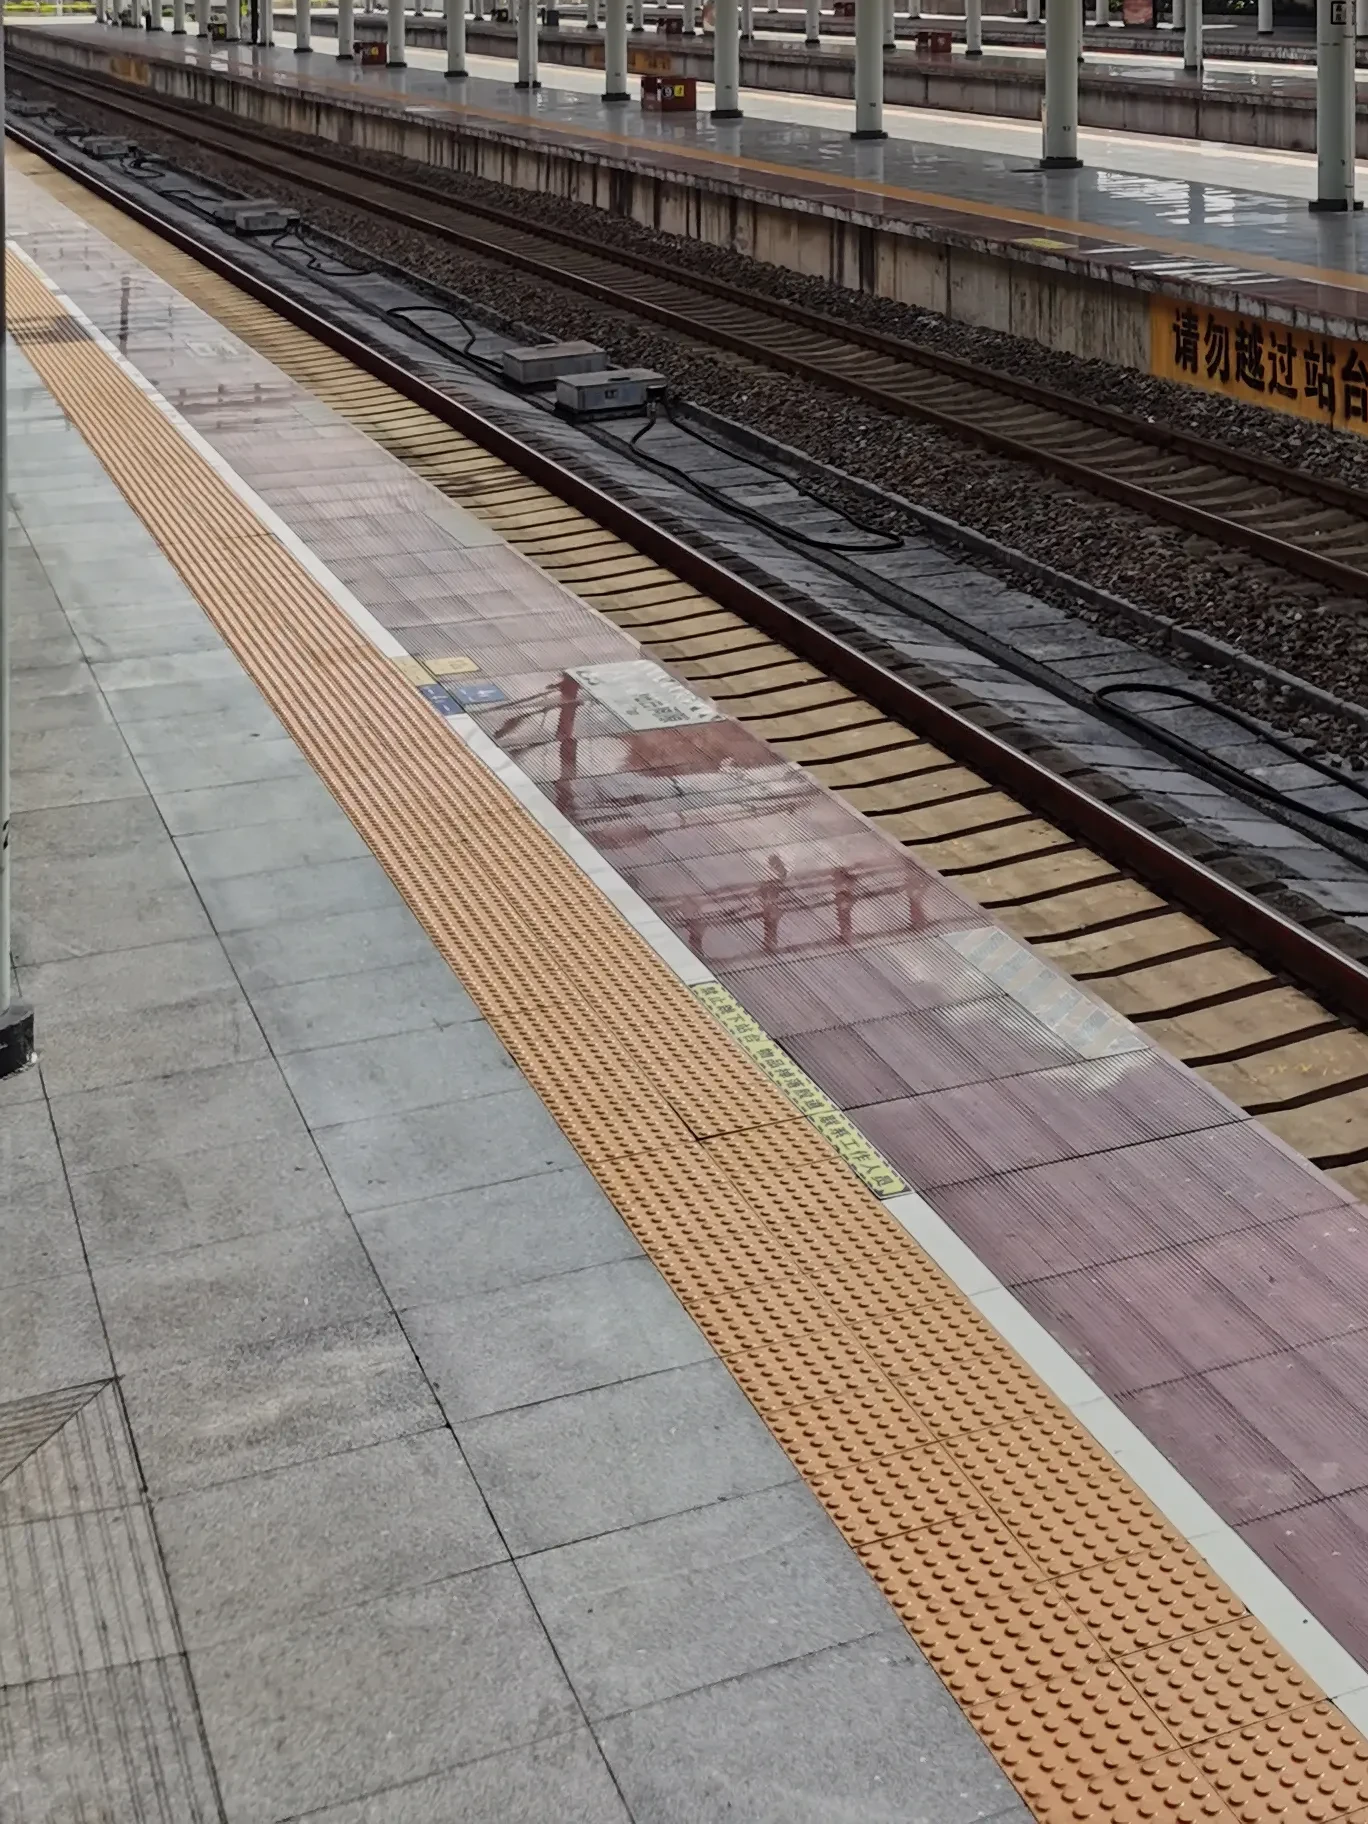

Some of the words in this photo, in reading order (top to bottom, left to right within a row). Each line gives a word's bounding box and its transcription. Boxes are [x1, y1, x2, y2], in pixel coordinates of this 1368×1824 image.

[818, 1114, 894, 1188] 联系工作人员
